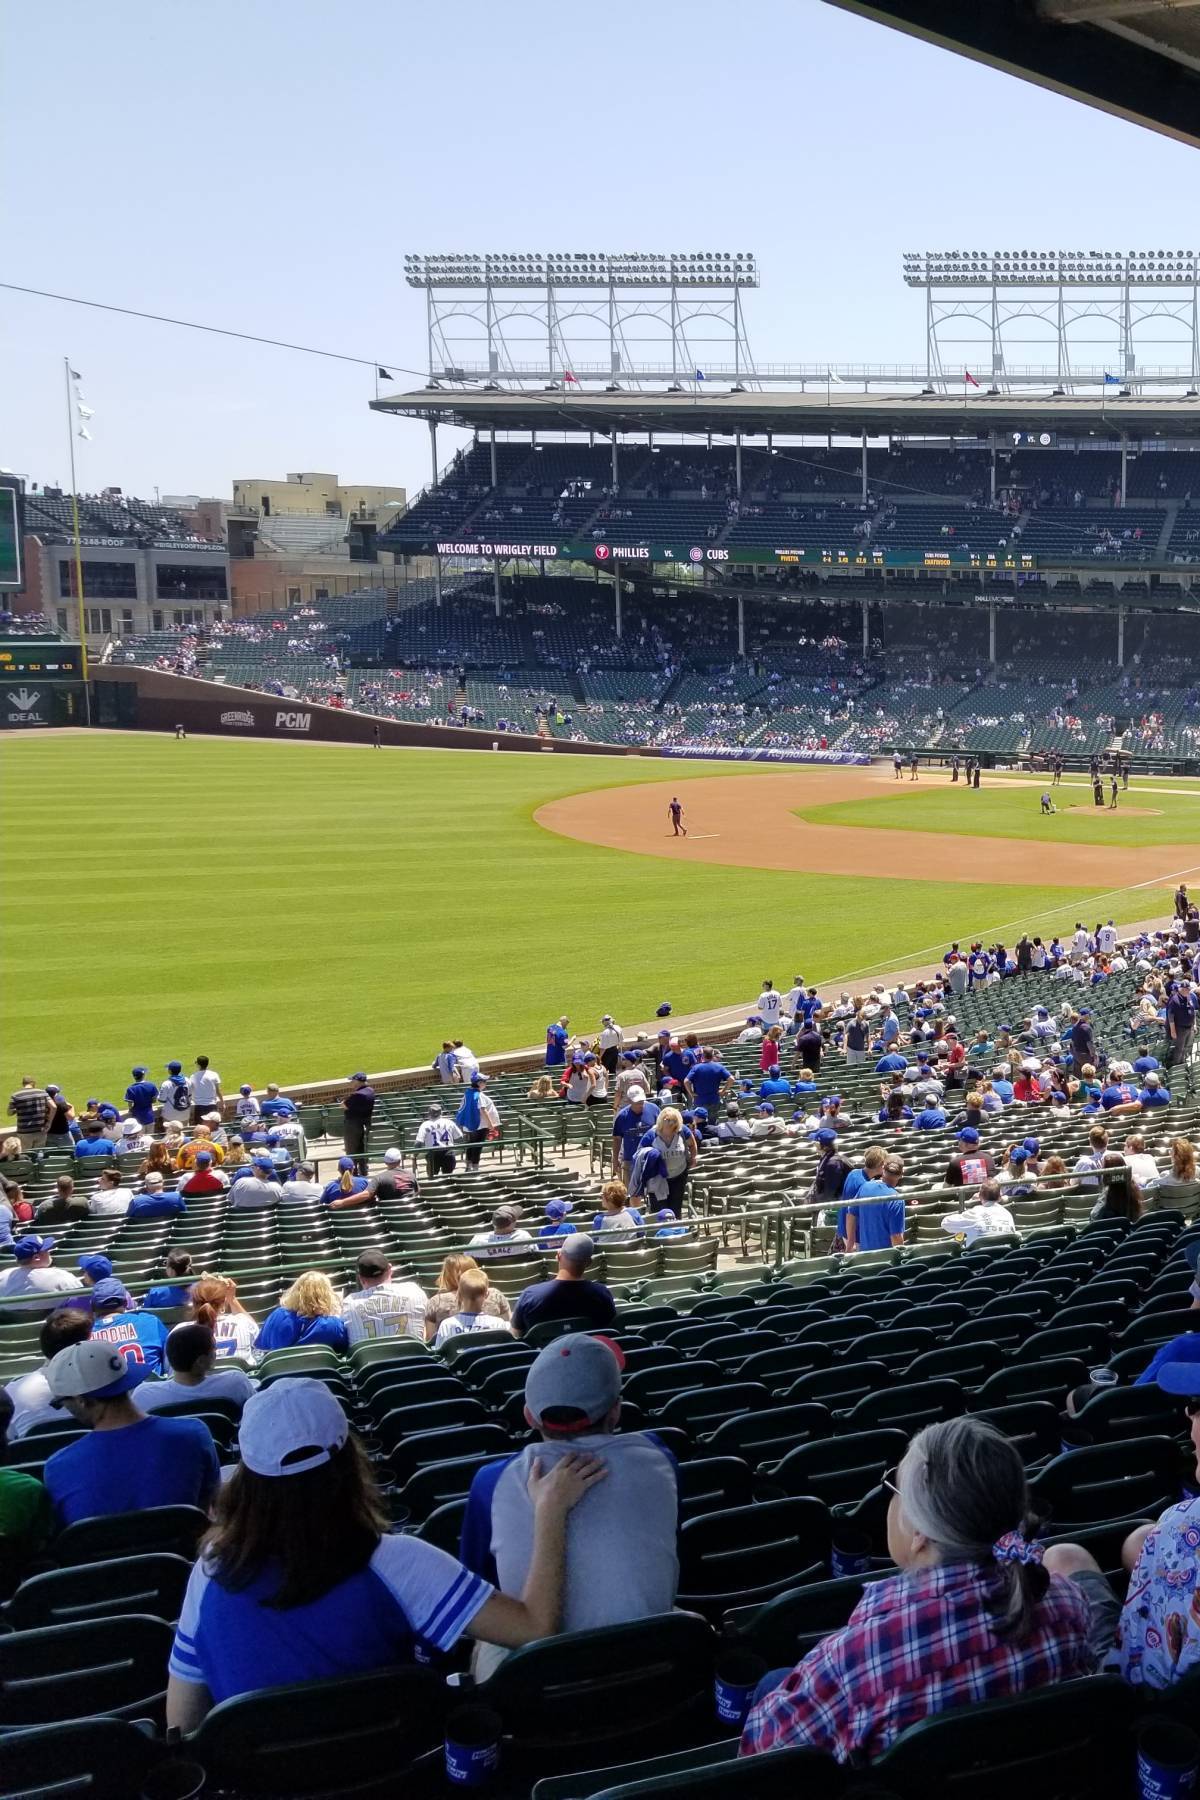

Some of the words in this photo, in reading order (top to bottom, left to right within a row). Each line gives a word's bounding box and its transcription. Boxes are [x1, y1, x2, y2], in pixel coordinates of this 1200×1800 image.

[437, 544, 478, 554] WELCOME
[481, 544, 492, 554] TO
[494, 545, 531, 555] WRIGLEY
[534, 546, 556, 556] FIELD
[612, 547, 649, 558] PHILLIES
[706, 550, 729, 560] CUBS
[275, 712, 311, 728] PCM
[716, 747, 743, 758] Wrap
[767, 749, 814, 760] Reynolds
[814, 751, 842, 762] Wrap
[768, 1000, 778, 1010] 17
[431, 1129, 450, 1146] 14
[363, 1313, 408, 1338] 17
[109, 1356, 121, 1371] C
